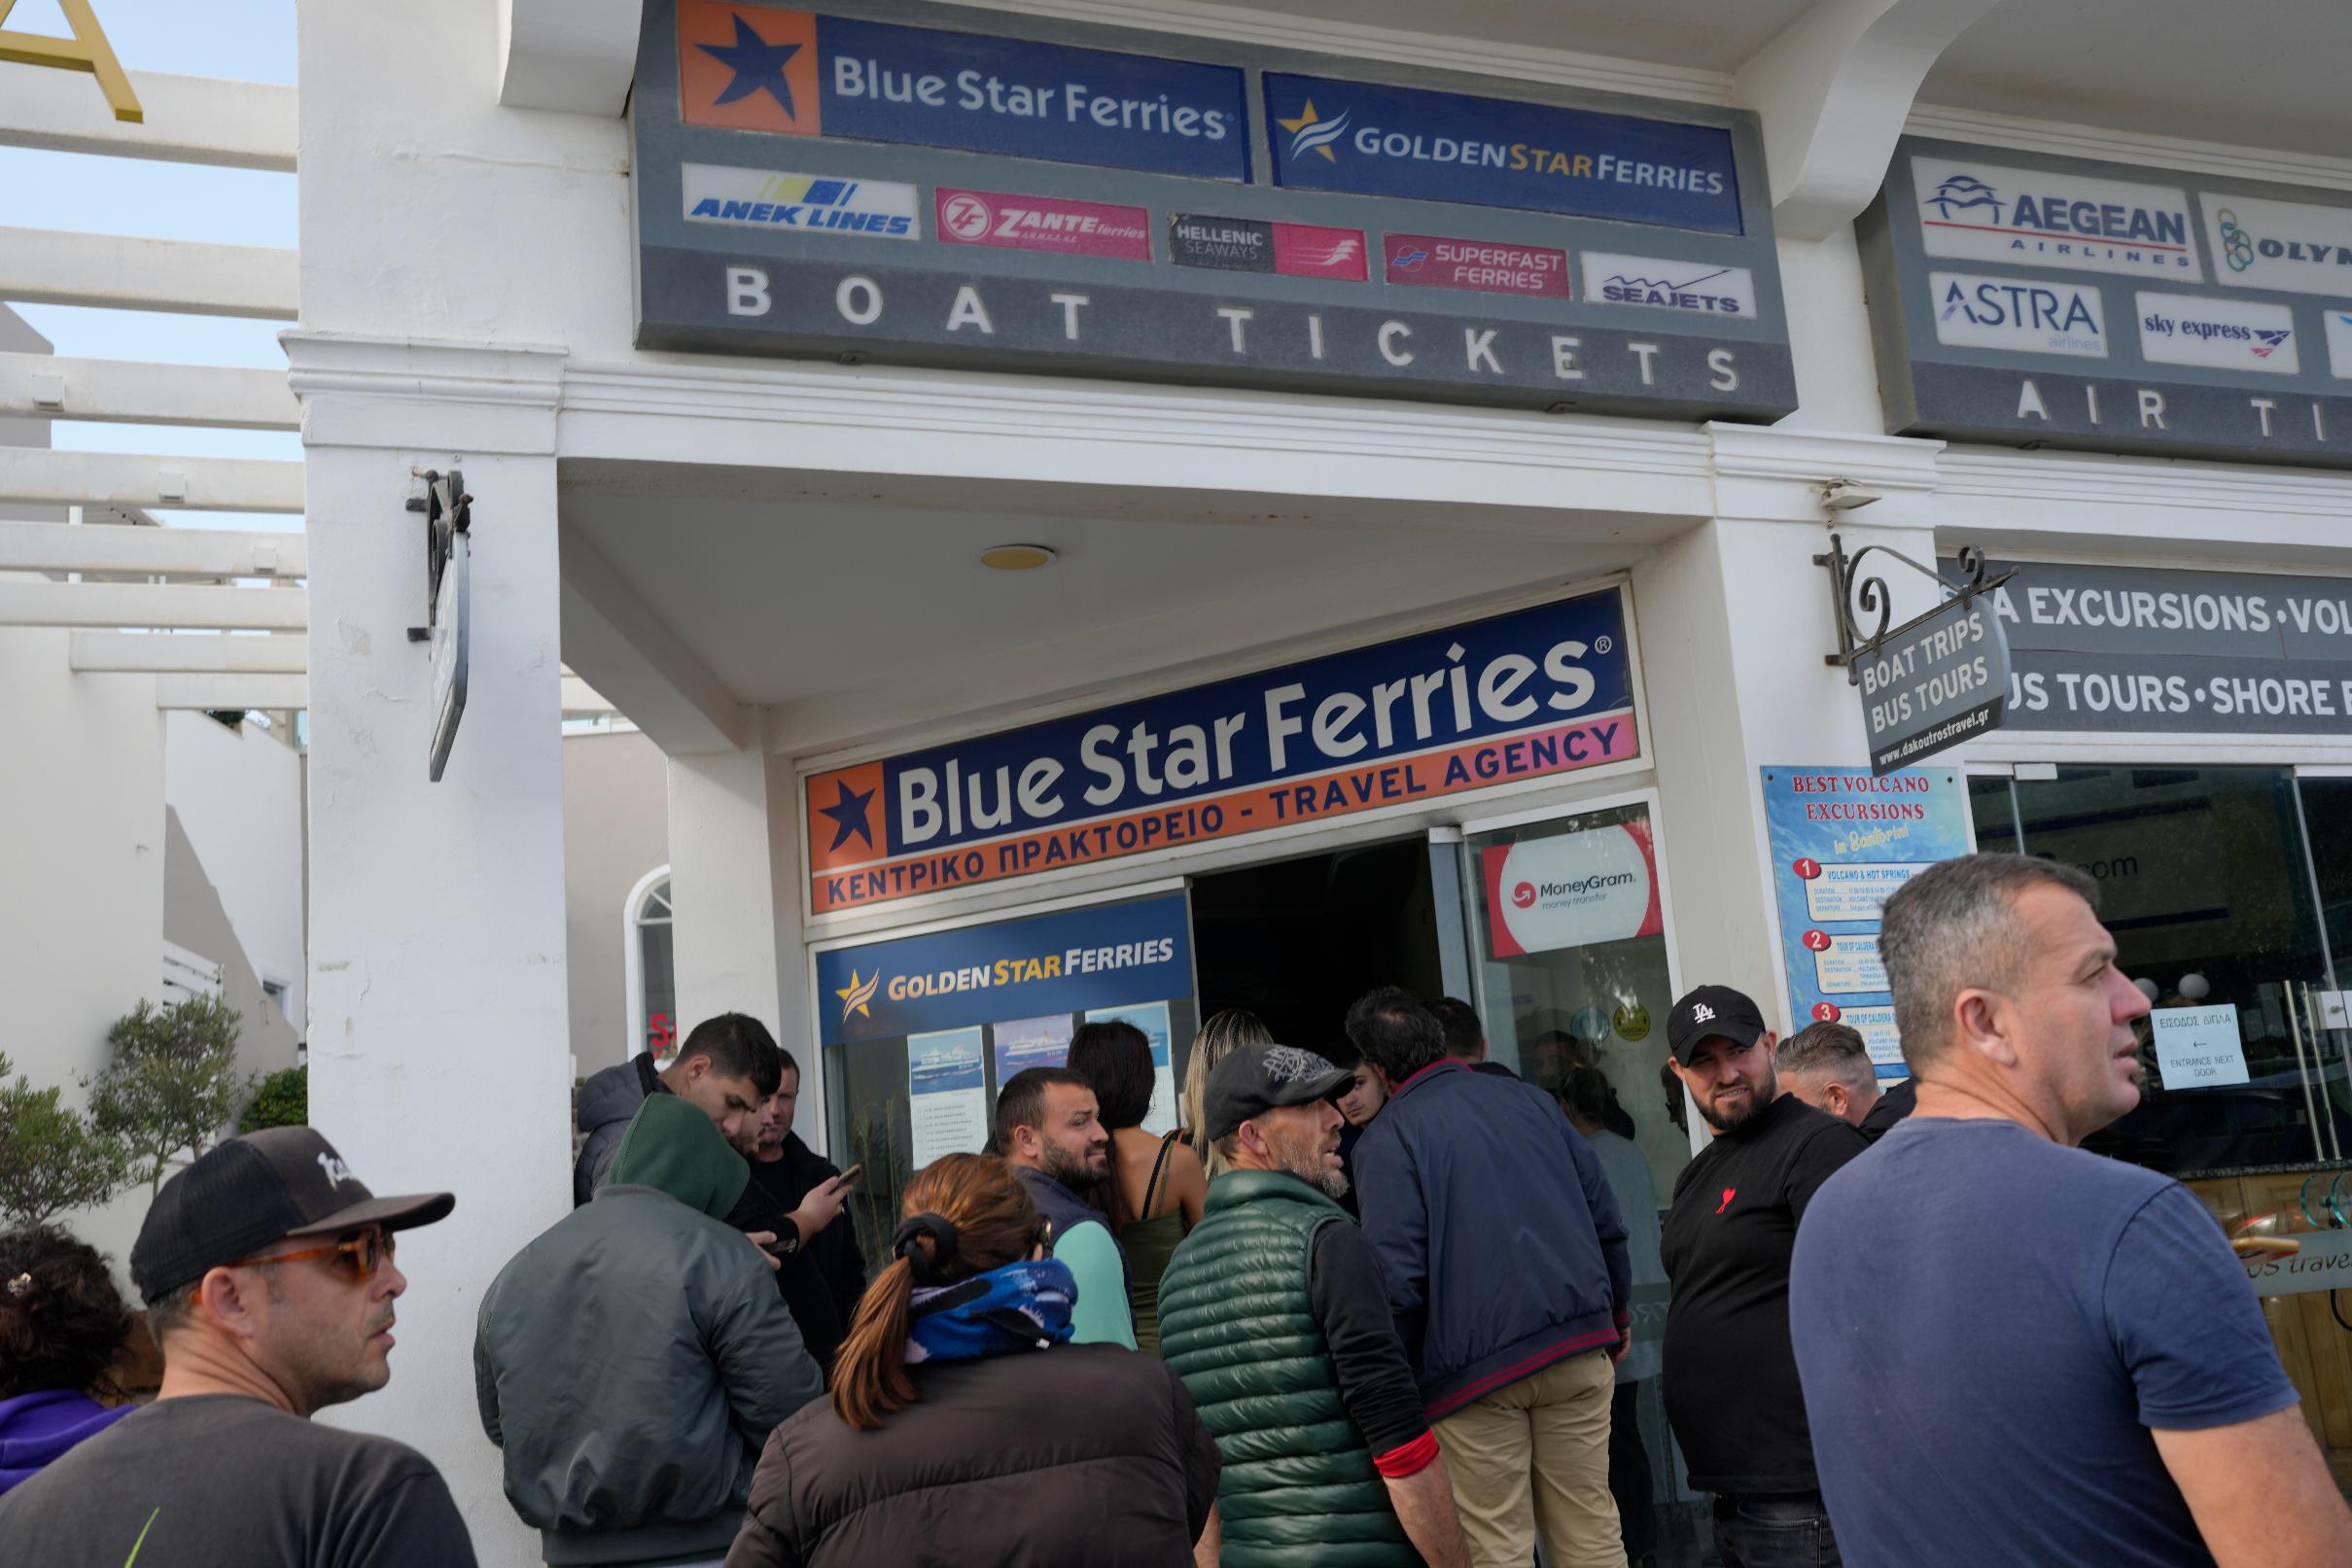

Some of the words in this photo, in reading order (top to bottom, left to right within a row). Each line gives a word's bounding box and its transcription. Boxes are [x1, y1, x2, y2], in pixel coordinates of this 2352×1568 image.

[835, 55, 945, 108] Blue
[957, 71, 1054, 118] Star
[690, 198, 806, 226] ANEK
[807, 207, 912, 236] LINES
[993, 208, 1100, 237] ZANTE
[1096, 224, 1146, 240] ferries
[2012, 194, 2186, 245] AEGEAN
[1177, 225, 1262, 246] HELLENIC
[1185, 240, 1258, 260] SEAWAYS
[1435, 245, 1562, 272] SUPERFAST
[2011, 239, 2190, 267] AIRLINES
[1454, 266, 1545, 290] FERRIES
[1603, 286, 1739, 314] SEAJETS
[1942, 281, 2099, 334] ASTRA
[726, 265, 1089, 340] BOAT
[1217, 307, 1740, 392] TICKETS
[2144, 315, 2175, 337] sky
[2182, 320, 2251, 343] express
[2048, 333, 2100, 352] airlines
[2017, 379, 2168, 430] AIR
[1863, 645, 1915, 696] BOAT
[1920, 612, 1983, 666] TRIPS
[1871, 692, 1913, 734] BUS
[1914, 656, 1988, 713] TOURS
[2057, 673, 2191, 714] TOURS
[2210, 678, 2336, 716] SHORE
[1878, 708, 1989, 766] www.dakoutrostravel.gr
[899, 757, 1065, 846] Blue
[1080, 712, 1246, 807] Star
[1793, 776, 1838, 793] BEST
[1843, 776, 1930, 793] VOLCANO
[827, 851, 984, 905] ΚΕΝΤΡΙΚΟ
[999, 803, 1224, 873] ΠΡΑΚΤΟΡΕΙΟ
[1269, 764, 1426, 820] TRAVEL
[1444, 722, 1620, 788] AGENCY
[1806, 803, 1925, 820] EXCURSIONS
[1802, 859, 1810, 877] 1
[1827, 870, 1858, 880] VOLCANO
[1867, 870, 1879, 880] HOT
[1881, 869, 1911, 879] SPRINGS
[1540, 872, 1634, 899] MoneyGram
[1542, 898, 1570, 910] money
[1572, 891, 1608, 908] transfer
[1810, 931, 1822, 949] 2
[1692, 1002, 1716, 1024] LA
[1821, 1004, 1831, 1021] 3
[2159, 1016, 2199, 1028] ΕΙΣΟΔΟΣ
[2170, 1057, 2212, 1068] ENTRANCE
[2215, 1055, 2234, 1064] NEXT
[2194, 1067, 2217, 1077] DOOR
